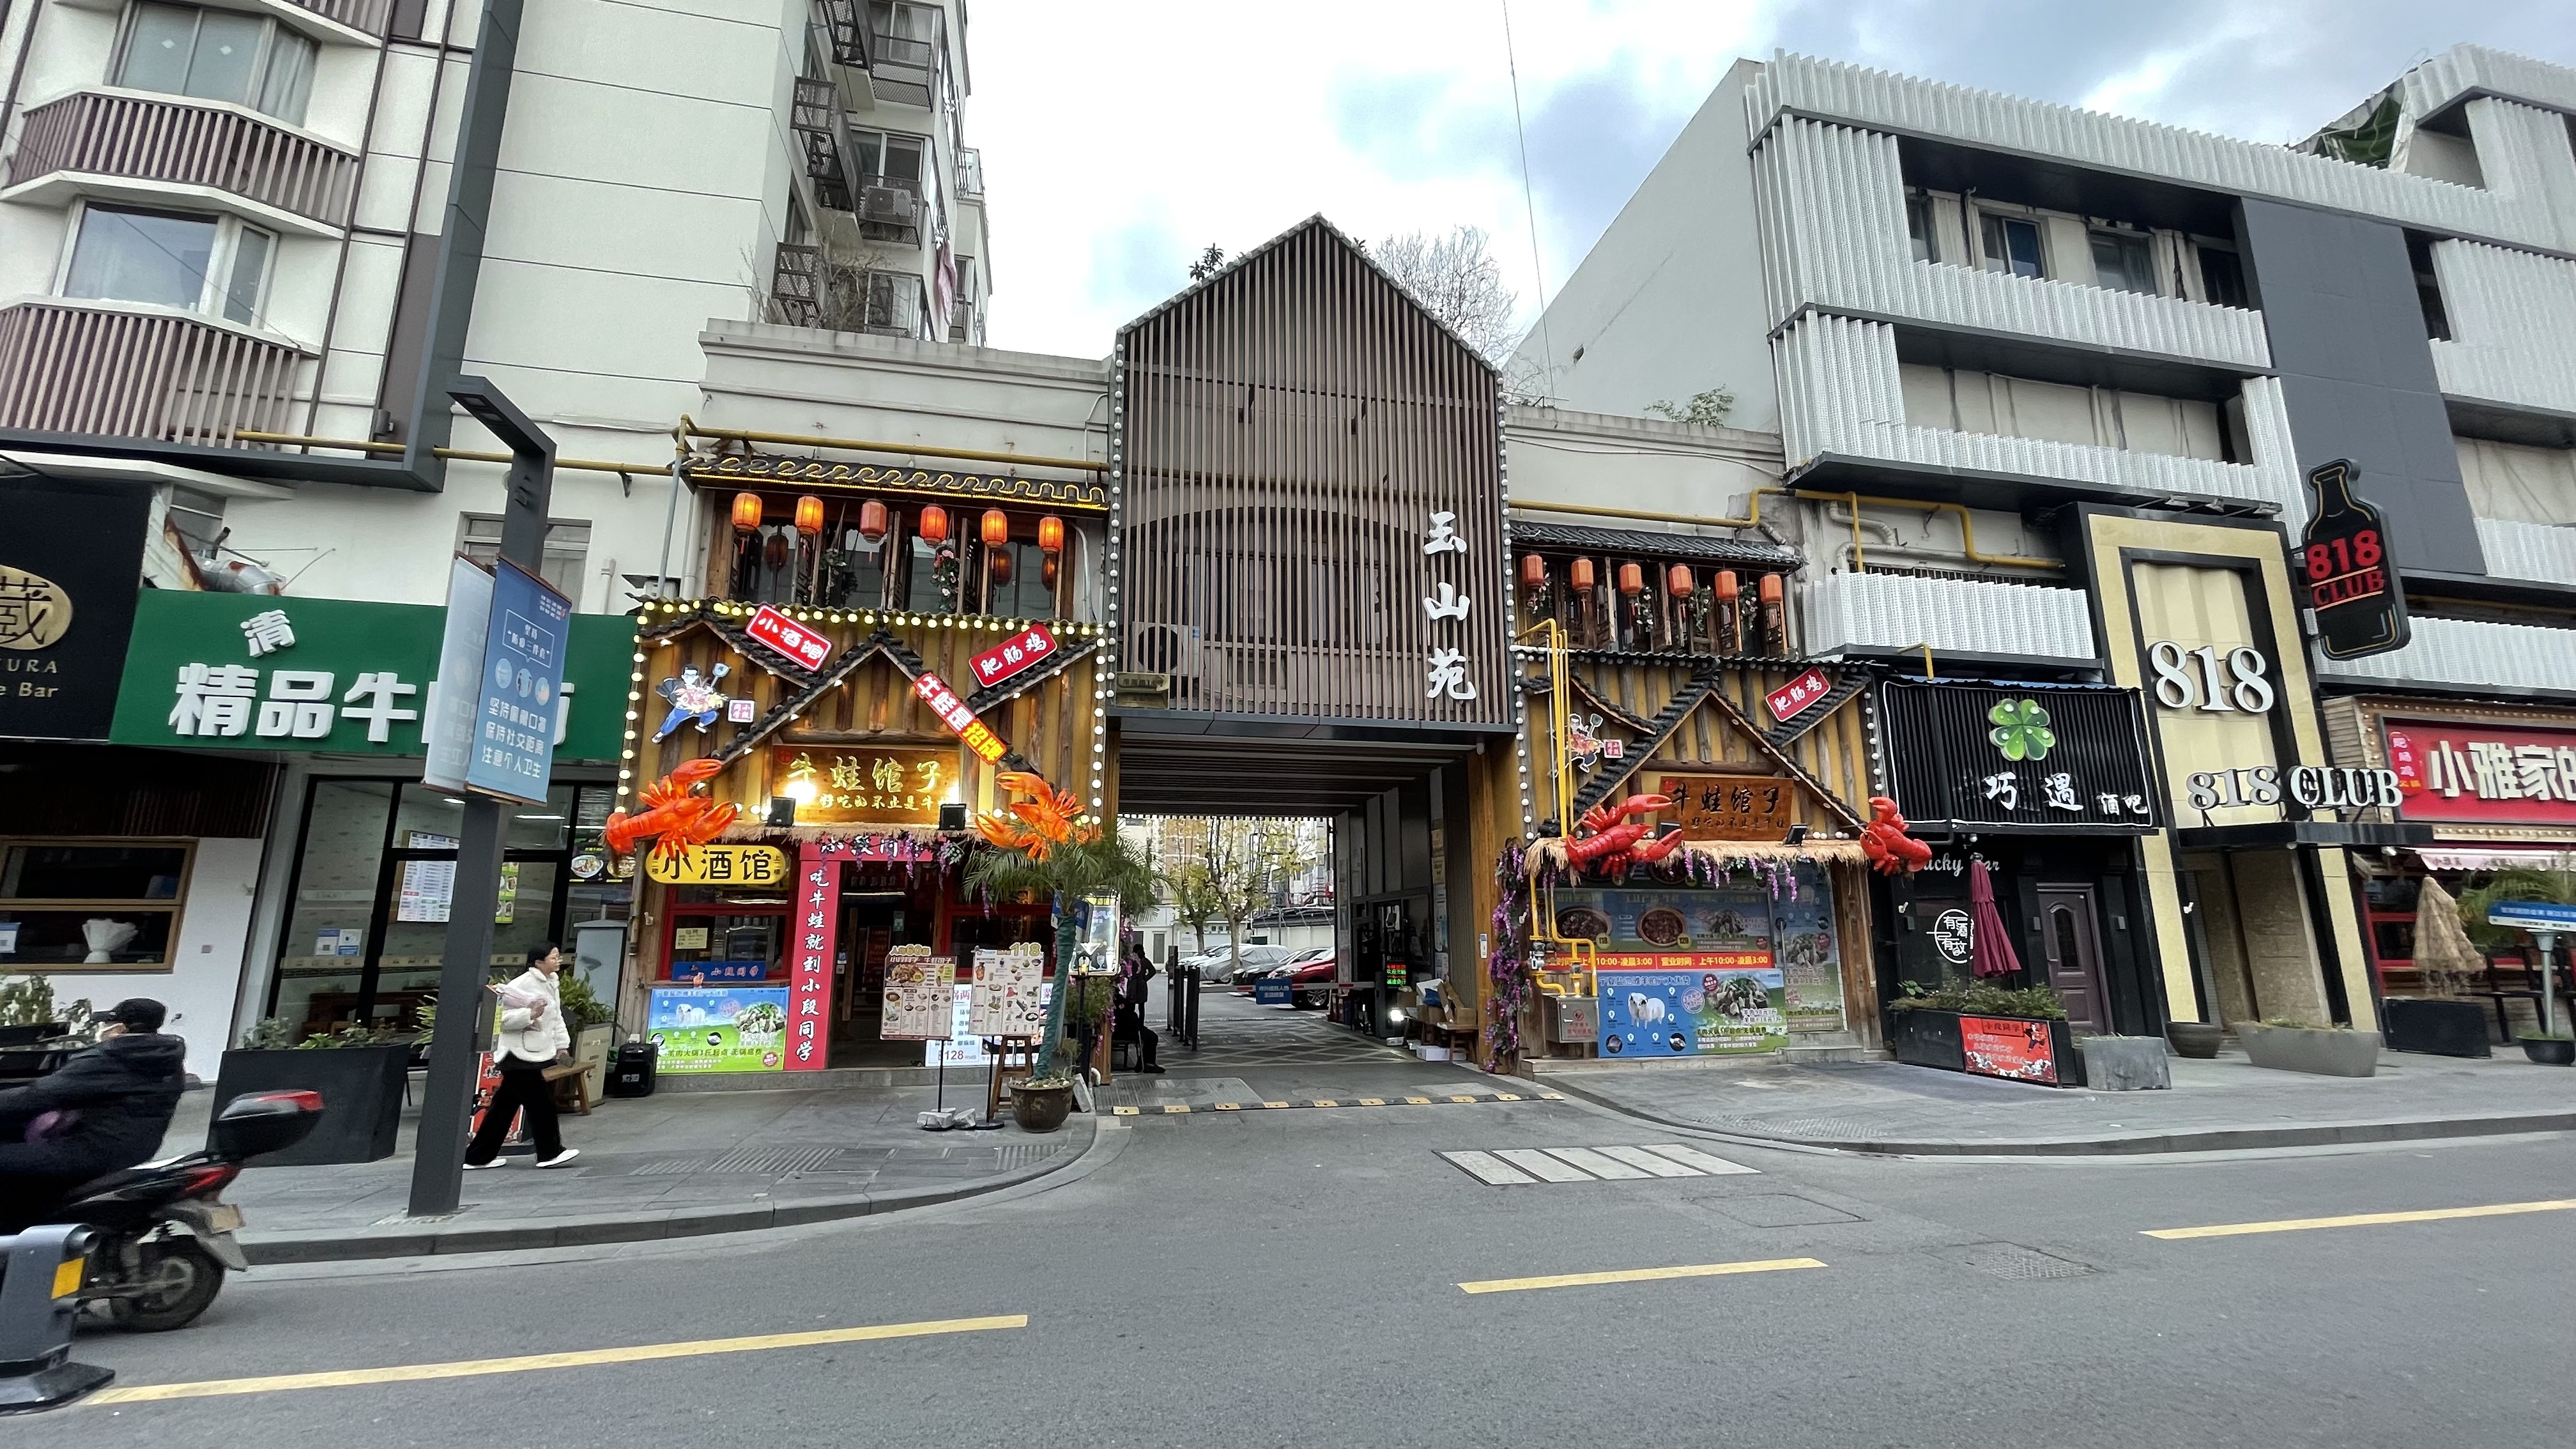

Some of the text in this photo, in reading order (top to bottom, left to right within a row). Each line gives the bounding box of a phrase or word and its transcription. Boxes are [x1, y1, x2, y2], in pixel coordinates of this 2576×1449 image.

[2307, 530, 2381, 579] 818
[1423, 510, 1476, 700] 玉山苑
[2313, 571, 2384, 606] CLUB
[240, 608, 296, 657] 清
[758, 617, 824, 660] 小酒馆
[0, 658, 57, 673] URA
[979, 632, 1047, 677] 肥肠鸡
[19, 682, 59, 698] Bar
[1774, 675, 1822, 712] 肥肠鸡
[2148, 640, 2274, 714] 818
[168, 663, 575, 745] 精品牛
[917, 676, 1004, 762] 牛蛙是招牌
[486, 721, 544, 756] 保持社交距离
[482, 744, 542, 778] 注意个人卫生
[786, 752, 942, 793] 牛蛙馆子
[819, 793, 947, 811] 好吃的不止是牛
[1672, 781, 1779, 816] 牛蛙馆子
[1981, 771, 2148, 815] 巧遇 酒吧
[2186, 765, 2403, 810] 818 CLUB
[662, 850, 772, 880] 小酒馆
[1923, 852, 1963, 877] ucky
[796, 870, 829, 1062] 吃牛蛙就到小段同学
[1010, 942, 1041, 957] 118
